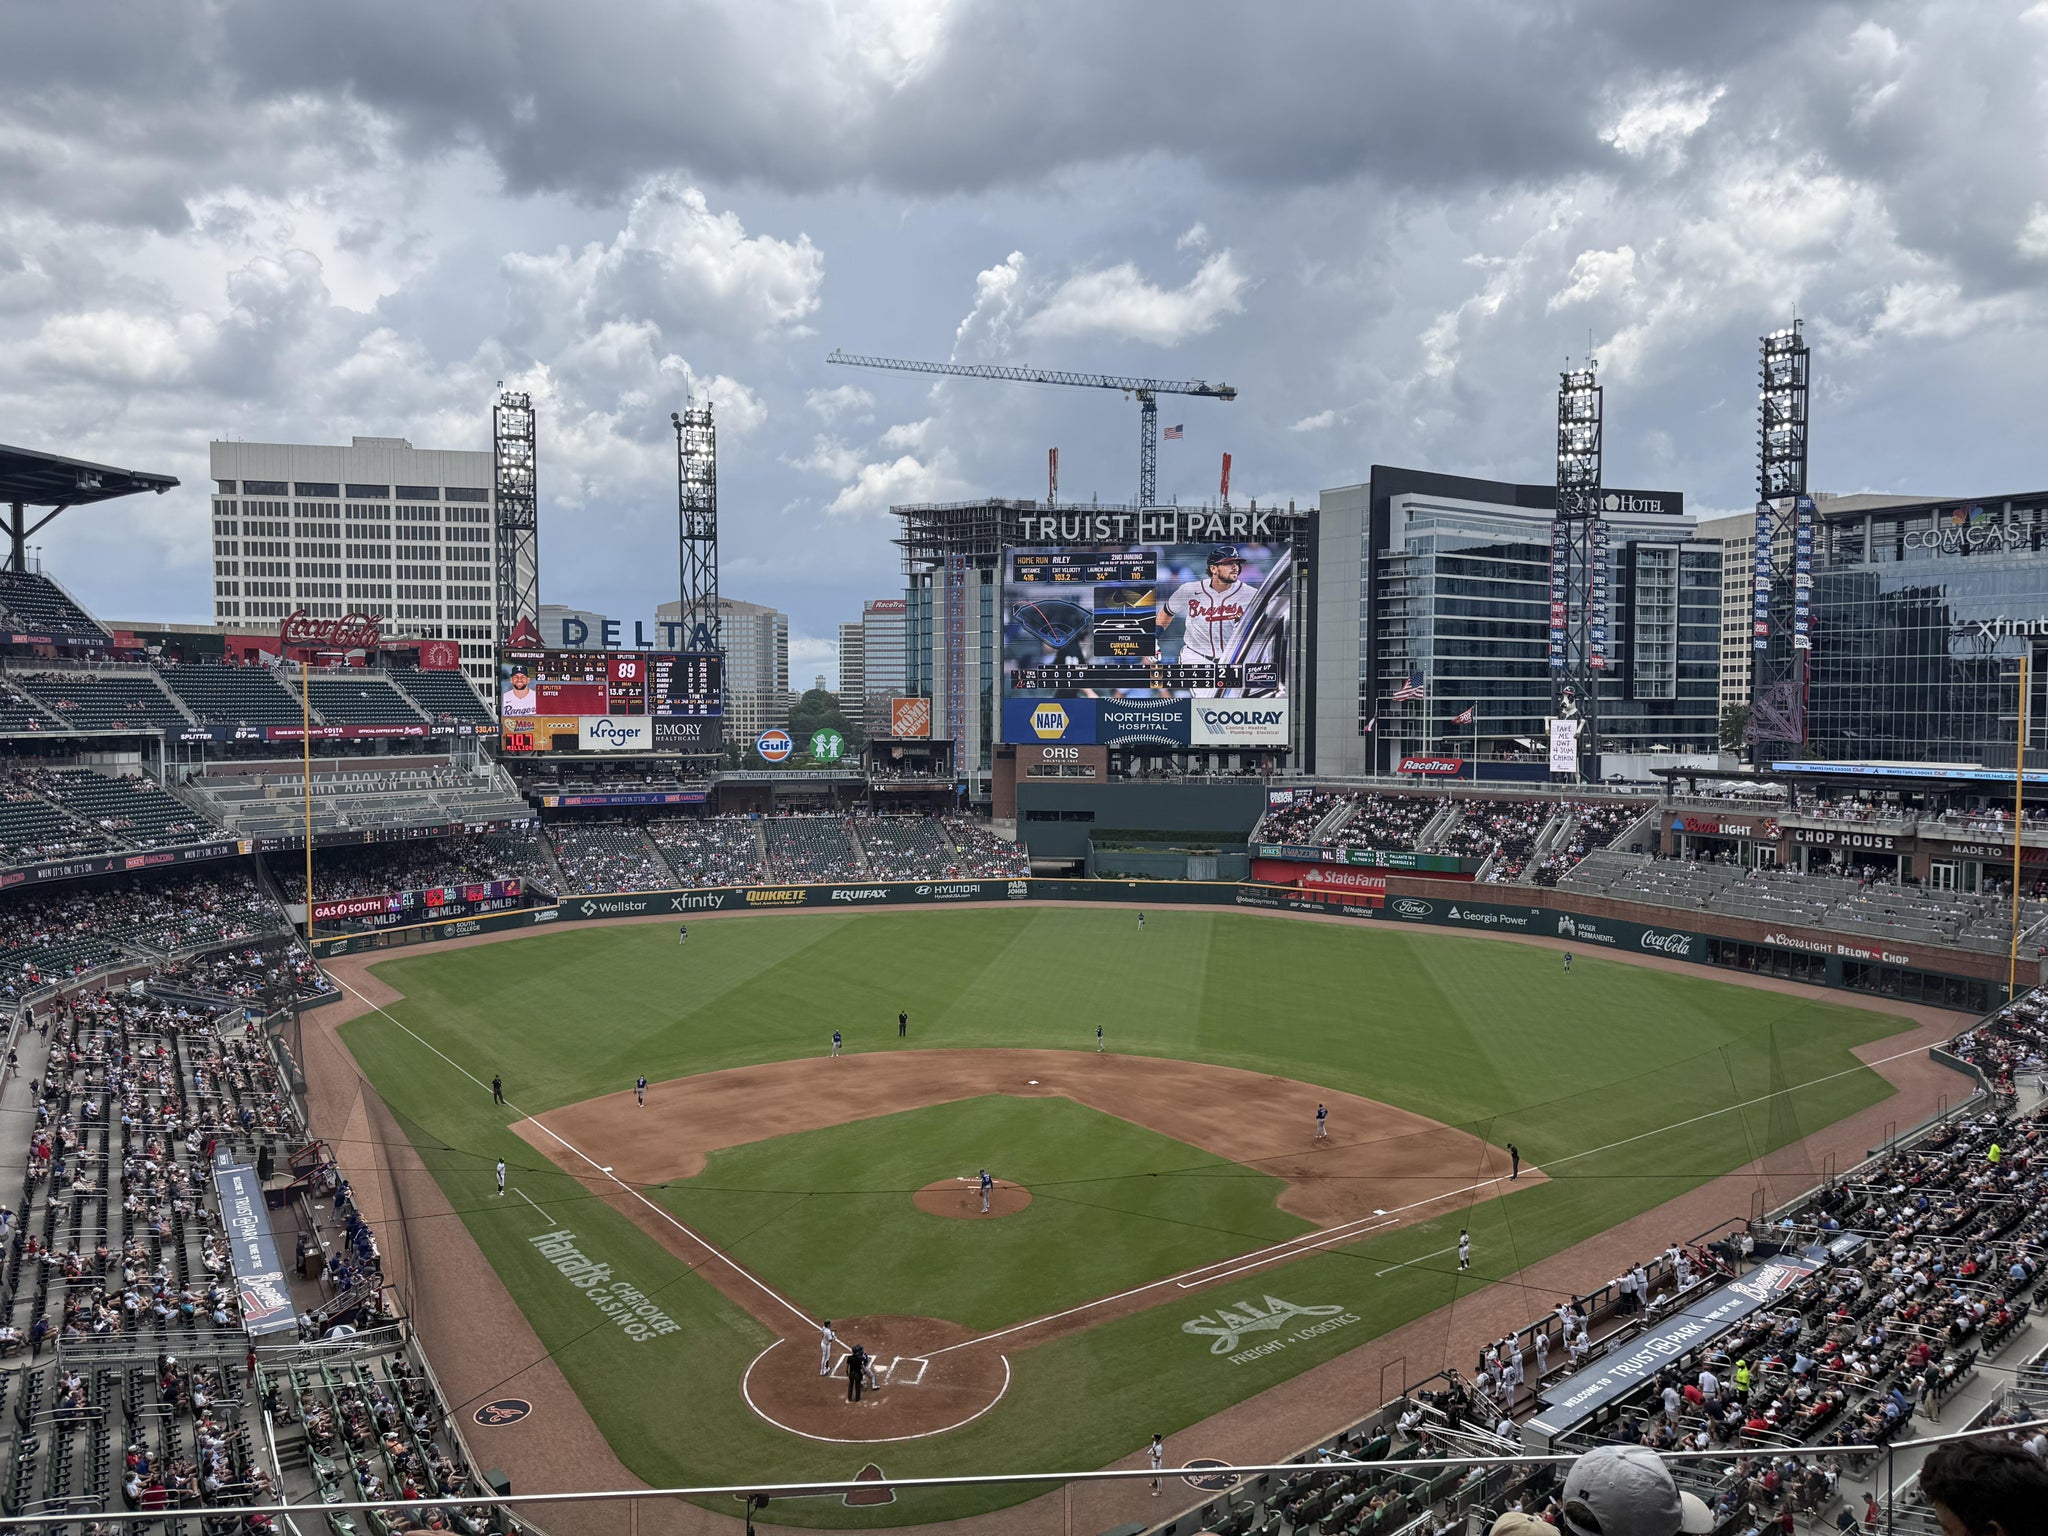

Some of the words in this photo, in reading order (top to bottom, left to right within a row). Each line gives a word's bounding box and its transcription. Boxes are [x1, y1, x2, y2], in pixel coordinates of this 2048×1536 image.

[1620, 495, 1664, 512] HOTEL
[1018, 515, 1132, 540] TRUIST
[1187, 511, 1274, 537] PARK
[1798, 530, 1811, 538] 2001
[1903, 521, 2036, 549] COMCAST
[1798, 546, 1811, 554] 2003
[1035, 556, 1049, 564] RUN
[1052, 556, 1070, 564] RILEY
[1593, 562, 1605, 570] 1891
[1797, 561, 1810, 569] 2005
[1797, 576, 1809, 584] 2012
[1188, 599, 1243, 619] Braves
[1796, 607, 1809, 615] 2020
[281, 609, 384, 647] Coca-Cola
[1552, 618, 1563, 626] 1957
[1796, 623, 1808, 631] 2022
[1977, 614, 2048, 642] xfinit
[562, 618, 714, 649] DELTA
[1755, 624, 1767, 633] 2021
[1755, 640, 1767, 649] 2023
[1796, 637, 1808, 646] 2024
[1551, 645, 1563, 653] 1991
[1592, 644, 1604, 652] 1992
[618, 663, 636, 678] 89
[1218, 668, 1226, 678] 2
[1234, 668, 1239, 678] 1
[896, 702, 912, 717] THE
[893, 699, 928, 735] HOME
[1036, 712, 1063, 729] NAPA
[1104, 712, 1183, 722] NORTHSIDE
[1205, 711, 1284, 725] COOLRAY
[655, 724, 702, 735] EMORY
[907, 713, 930, 735] DEPOT
[1118, 723, 1168, 731] HOSPITAL
[235, 731, 247, 739] 89
[590, 719, 641, 746] Kroger
[759, 739, 790, 752] Gulf
[1042, 747, 1079, 759] ORIS
[1403, 761, 1455, 771] RaceTrac
[279, 773, 336, 796] HANK
[331, 771, 398, 794] AARON
[390, 769, 473, 791] TERRACE
[1685, 817, 1719, 833] Coors
[1718, 824, 1752, 836] LIGHT
[1795, 830, 1835, 844] CHOP
[1841, 833, 1894, 849] HOUSE
[1282, 848, 1320, 858] AMAZING
[1322, 851, 1334, 859] NL
[1952, 845, 1984, 855] MADE
[1987, 847, 2002, 857] TO
[37, 868, 51, 879] WHEN
[934, 884, 980, 894] HYUNDAI
[1008, 880, 1027, 889] PAPA
[671, 892, 725, 911] xfinity
[746, 890, 806, 901] QUIKRETE
[831, 889, 888, 902] EQUIFAX
[315, 906, 336, 917] GAS
[348, 901, 381, 913] SOUTH
[387, 898, 400, 908] AL
[491, 899, 518, 910] MLB+
[599, 902, 647, 913] Wellstar
[1399, 901, 1426, 914] Ford
[440, 906, 466, 917] MLB+
[1349, 907, 1373, 915] National
[374, 913, 402, 925] MLB+
[1463, 911, 1498, 924] Georgia
[1499, 914, 1527, 926] Power
[456, 925, 480, 933] COLLEGE
[1578, 923, 1596, 932] KAISER
[1578, 931, 1616, 943] PERMANENTE
[1640, 929, 1694, 956] Coca-Cola
[1775, 933, 1806, 949] Coors
[1805, 942, 1833, 953] LIGHT
[1837, 944, 1871, 959] BELOW
[1882, 952, 1909, 965] CHOP
[234, 1196, 253, 1217] TRUIST
[240, 1222, 259, 1242] PARK
[528, 1229, 615, 1288] Harrah's
[1727, 1263, 1786, 1303] Braves
[238, 1271, 291, 1308] Braves
[609, 1282, 682, 1335] CHEROKEE
[586, 1288, 657, 1342] CASINOS
[1181, 1295, 1345, 1355] SAIA
[1227, 1339, 1287, 1365] FREIGHT
[1294, 1313, 1361, 1341] LOGISTICS
[1561, 1384, 1603, 1408] WELCOME
[1597, 1377, 1613, 1386] TO
[1608, 1349, 1660, 1378] TRUIST
[1665, 1321, 1706, 1343] PARK
[1718, 1305, 1731, 1313] OF
[1726, 1298, 1744, 1308] THE
